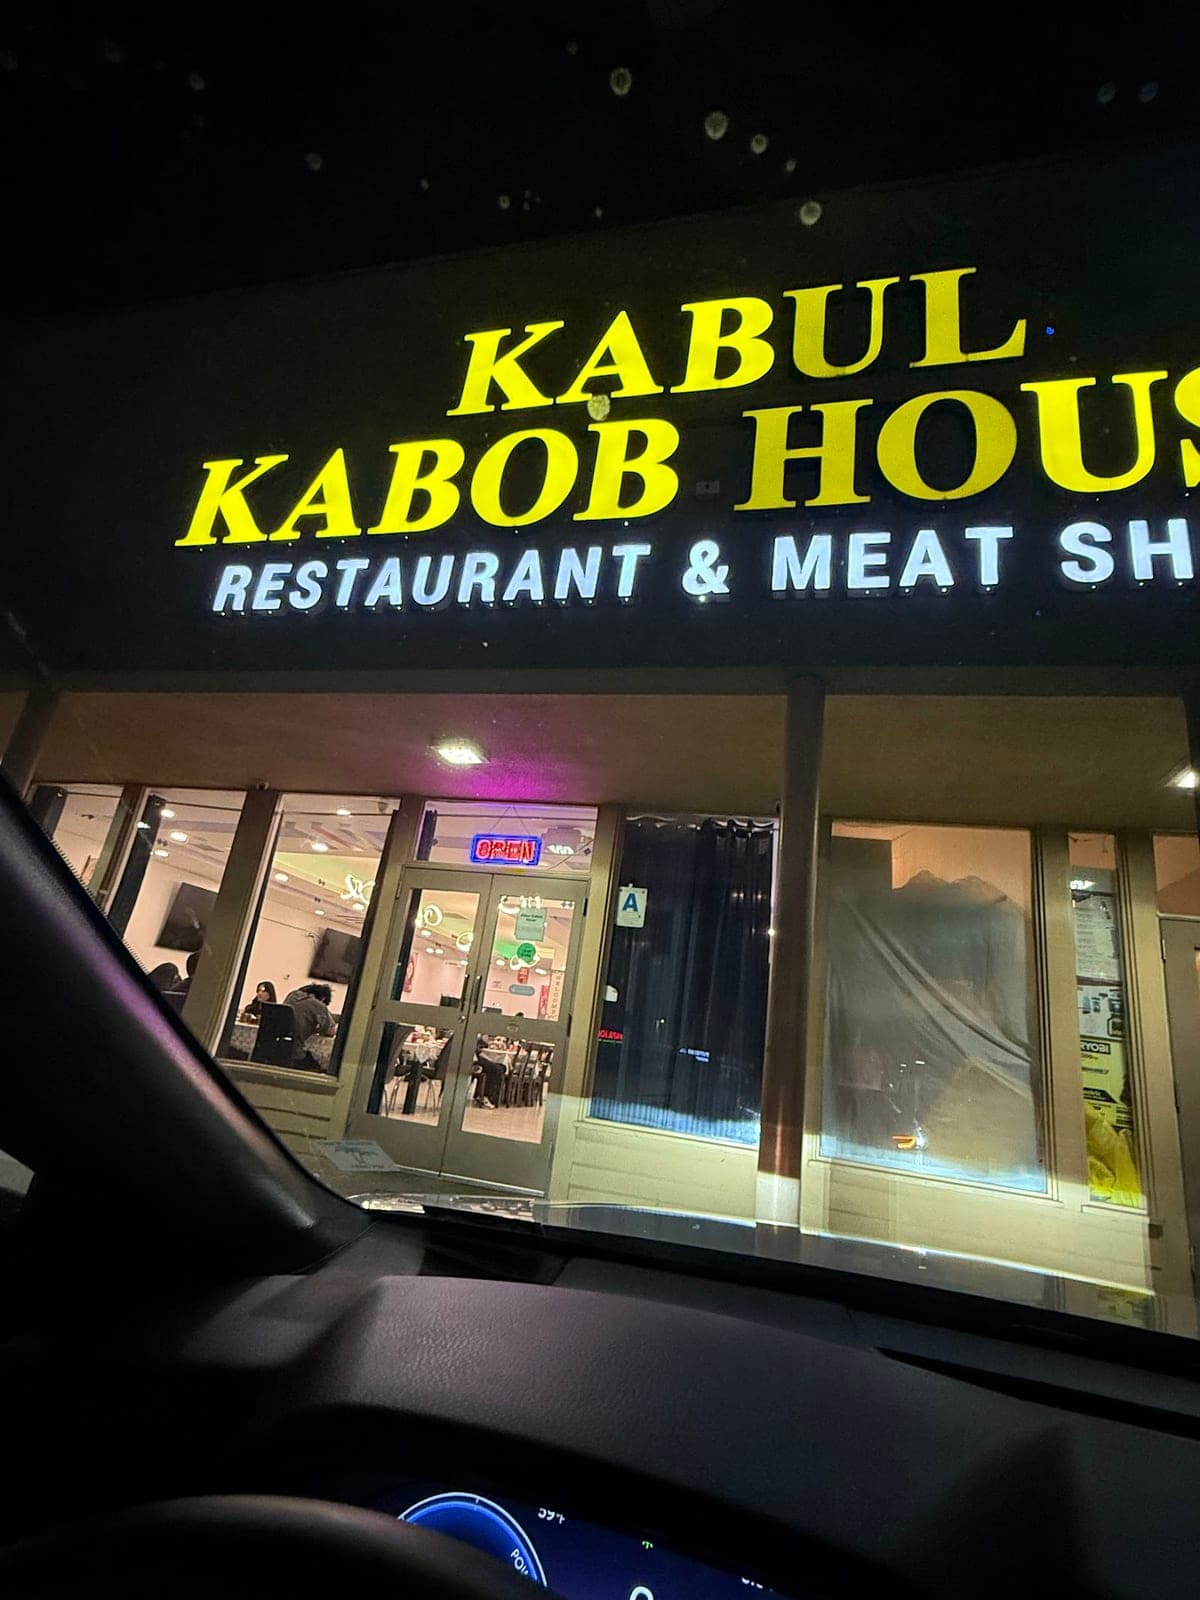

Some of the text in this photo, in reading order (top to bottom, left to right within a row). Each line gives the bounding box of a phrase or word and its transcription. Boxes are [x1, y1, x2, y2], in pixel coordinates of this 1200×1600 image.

[447, 267, 1027, 416] KABUL
[174, 418, 681, 547] KABOB
[212, 517, 1195, 612] RESTAURANT & MEAT SH
[475, 839, 536, 863] OPEN
[622, 892, 639, 912] A
